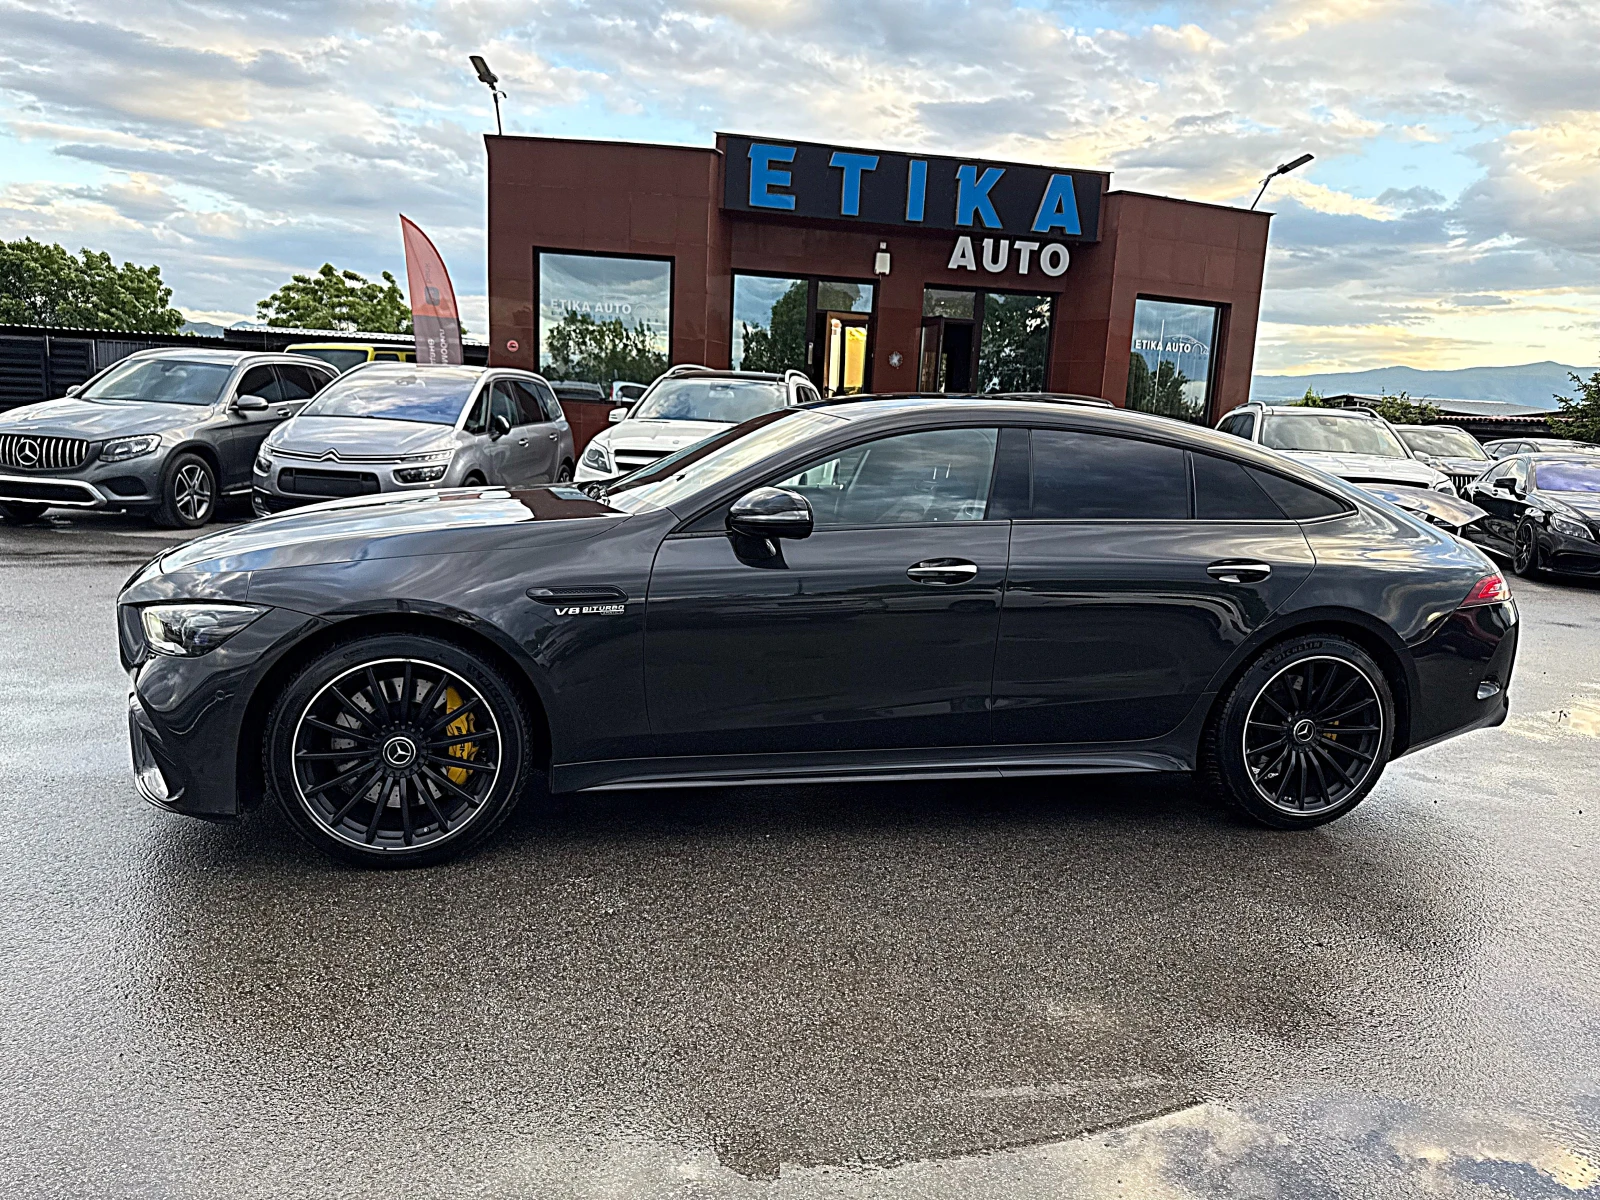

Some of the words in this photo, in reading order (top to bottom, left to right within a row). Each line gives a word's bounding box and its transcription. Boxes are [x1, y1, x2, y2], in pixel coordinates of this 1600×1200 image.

[748, 143, 1082, 235] ETIKA
[948, 236, 1070, 277] AUTO
[551, 299, 591, 312] ETIKA
[595, 302, 632, 315] AUTO
[1135, 340, 1163, 351] ETIKA
[1165, 342, 1191, 353] AUTO
[555, 607, 580, 616] V8
[582, 605, 625, 613] BITURBO
